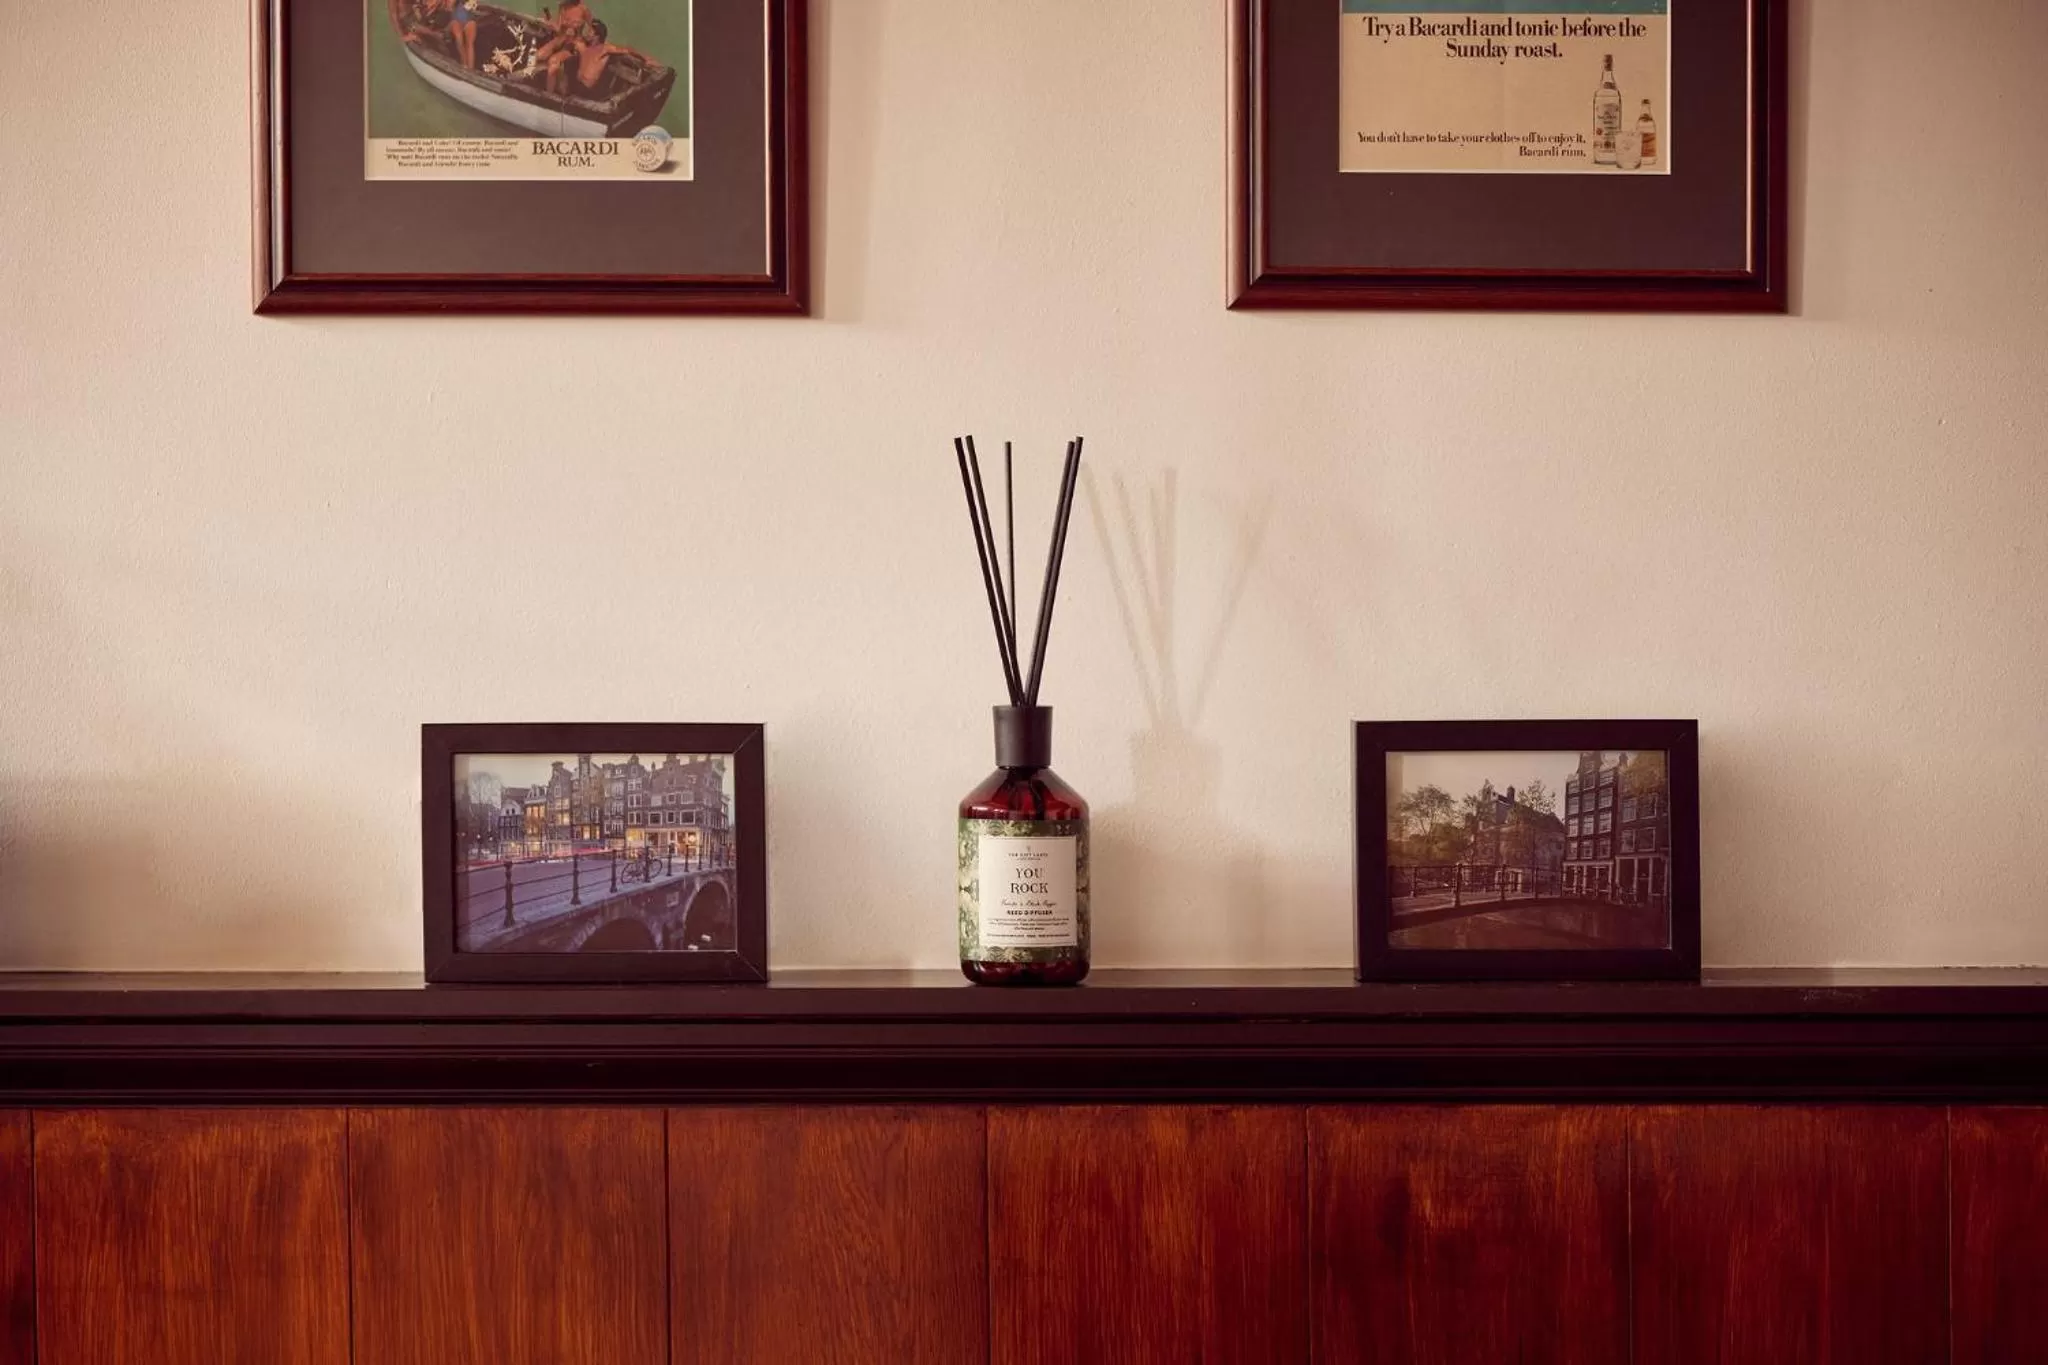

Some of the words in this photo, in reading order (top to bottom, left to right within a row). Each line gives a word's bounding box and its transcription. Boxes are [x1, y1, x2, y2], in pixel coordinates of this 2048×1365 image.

[1362, 16, 1391, 43] Try
[1394, 22, 1406, 37] a
[1409, 16, 1477, 37] Bacardi
[1479, 17, 1513, 37] and
[1515, 17, 1559, 37] tonic
[1562, 16, 1617, 37] before
[1619, 17, 1647, 37] the
[1446, 38, 1509, 64] Sunday
[1515, 42, 1563, 58] roast.
[1357, 131, 1376, 143] You
[1377, 131, 1400, 143] don't
[1402, 131, 1425, 143] have
[1426, 133, 1437, 143] to
[1438, 131, 1460, 143] take
[1459, 134, 1485, 147] your
[1485, 131, 1520, 143] clothes
[1522, 131, 1537, 143] off
[1537, 132, 1547, 143] to
[1548, 133, 1575, 147] enjoy
[532, 141, 619, 155] BACARDI
[1519, 145, 1559, 156] Bacardi
[558, 156, 595, 168] RUM.
[1016, 867, 1043, 879] YOU
[1010, 882, 1049, 895] ROCK
